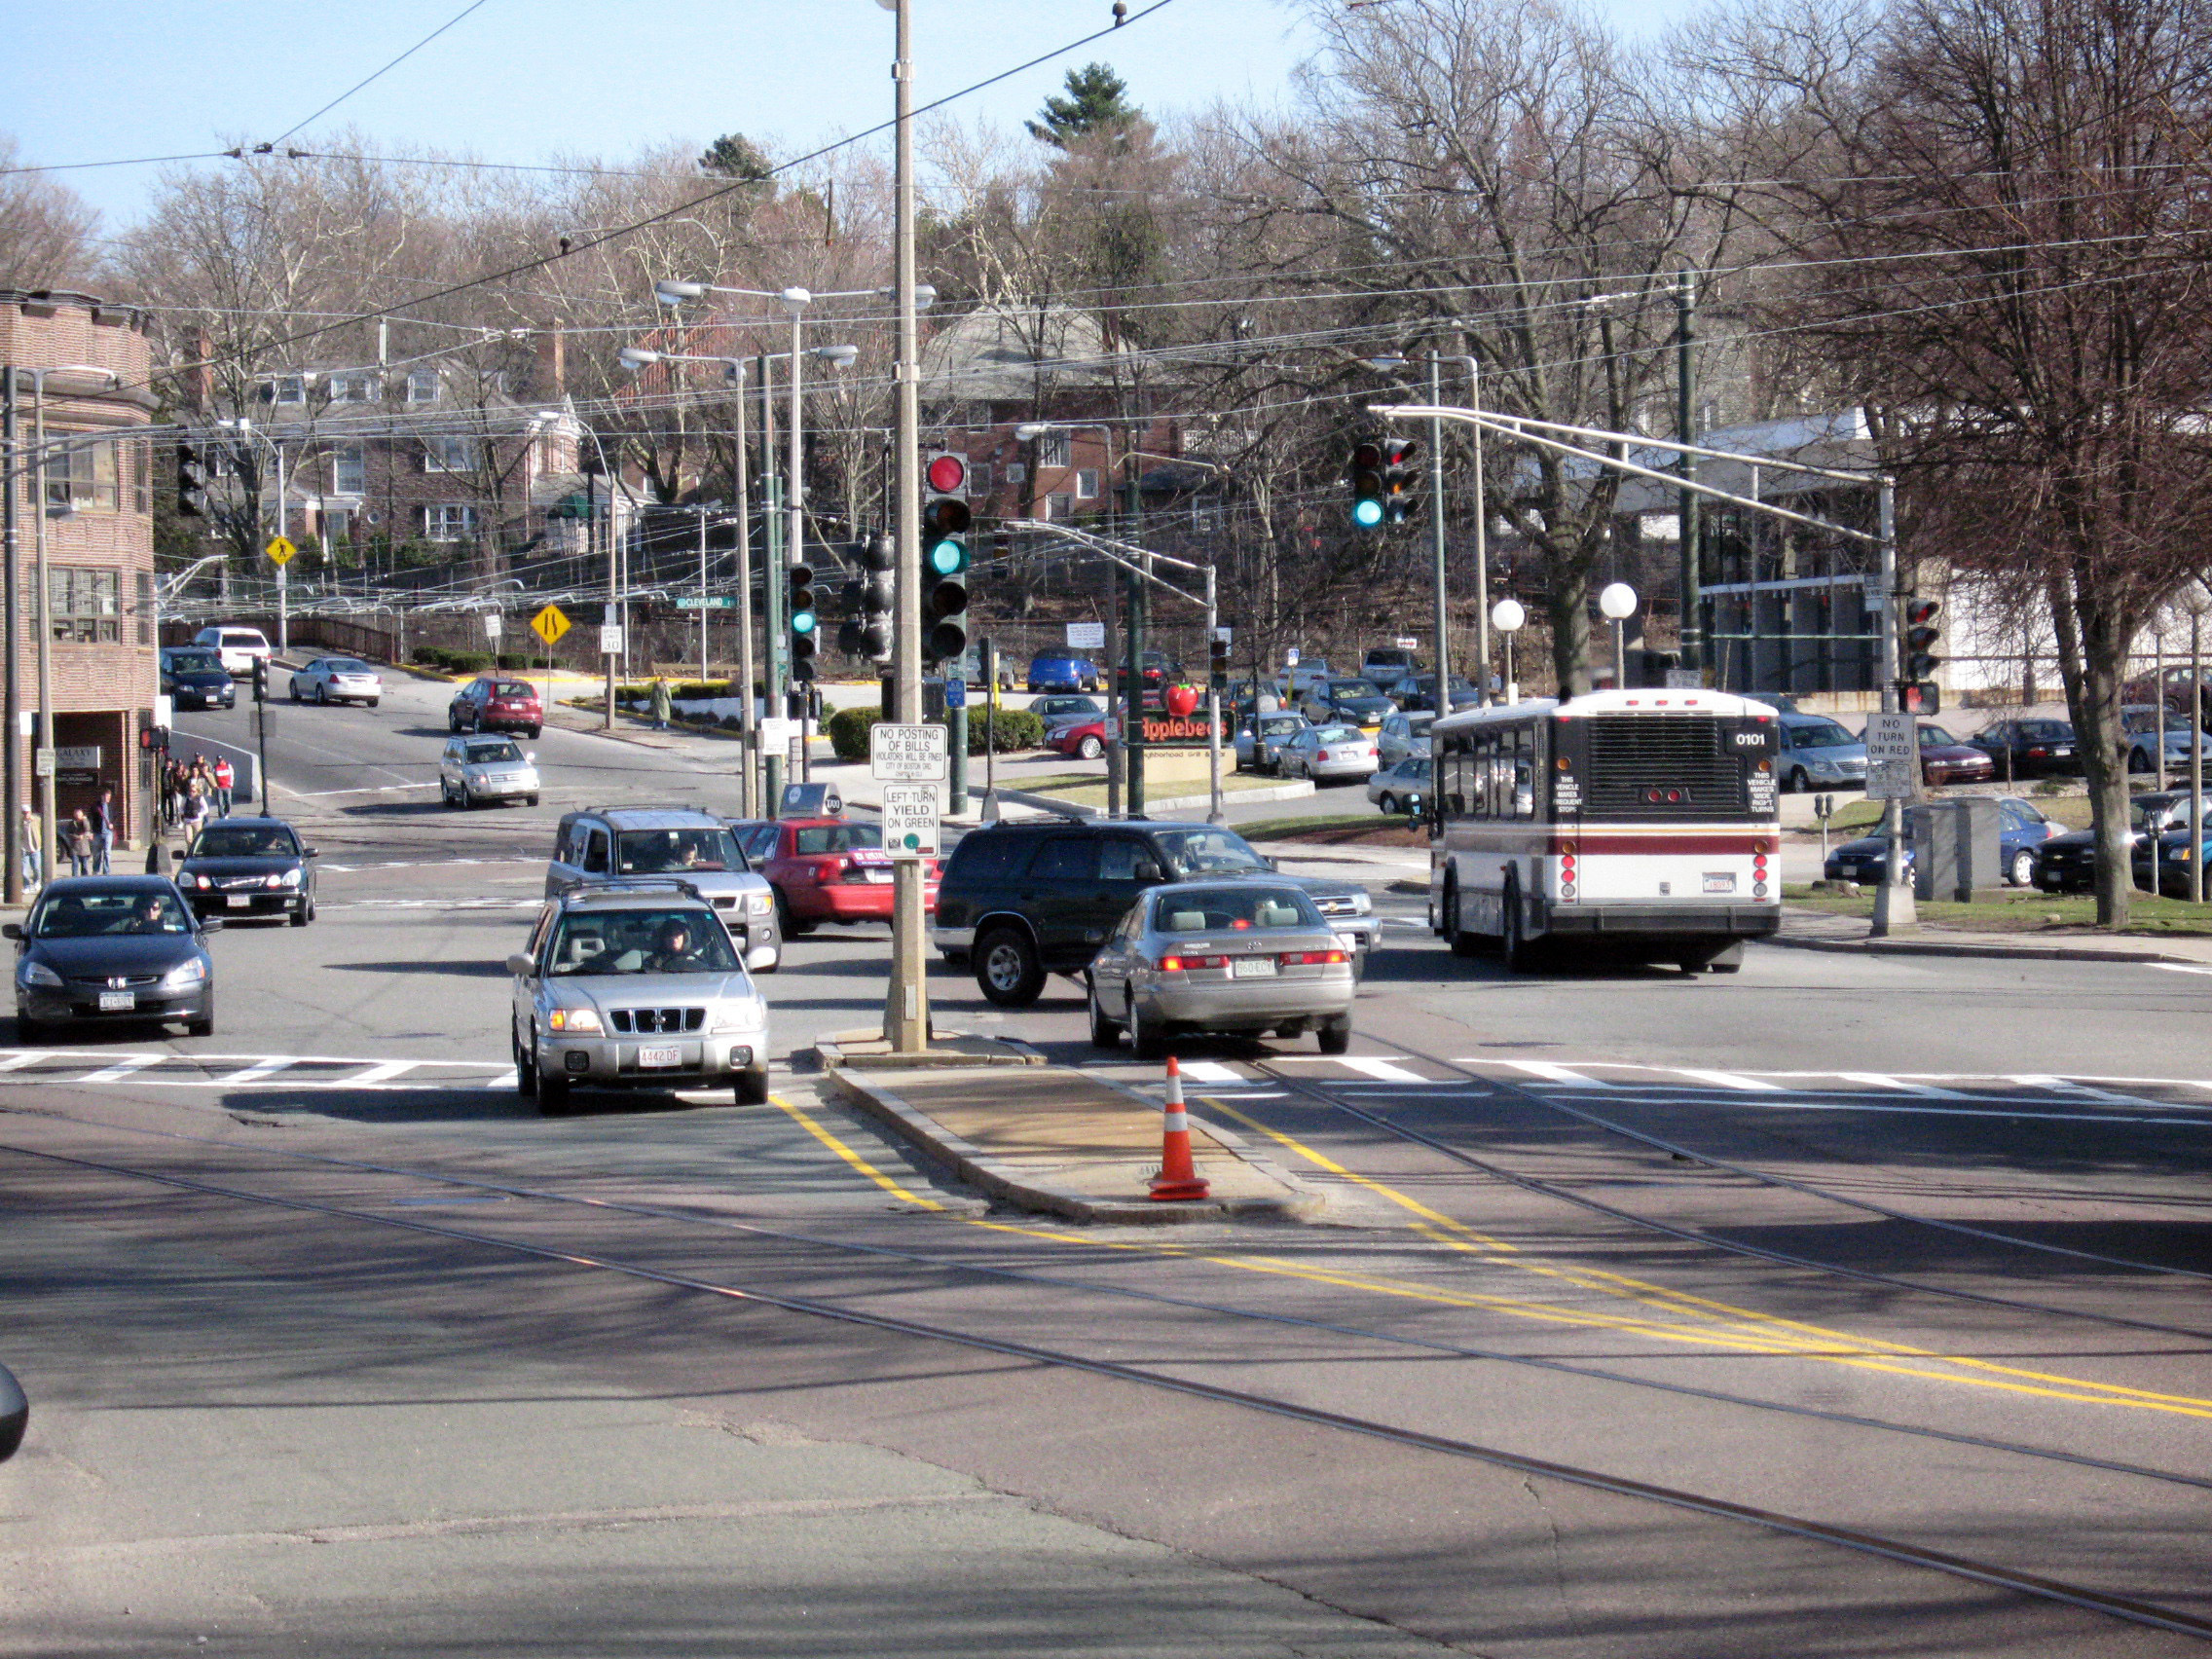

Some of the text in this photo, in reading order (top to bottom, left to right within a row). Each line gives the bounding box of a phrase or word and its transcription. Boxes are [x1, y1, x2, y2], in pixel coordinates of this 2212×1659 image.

[604, 641, 619, 649] 30
[1883, 719, 1900, 728] NO
[880, 729, 939, 740] NO POSTING
[1736, 733, 1766, 746] 0101
[1877, 732, 1905, 742] TURN
[888, 741, 930, 752] OF BILLS
[1871, 745, 1910, 755] ON RED
[919, 753, 926, 761] BE
[929, 753, 943, 761] FINED
[887, 793, 935, 803] LEFT TURN
[826, 798, 840, 809] TAXI
[893, 805, 929, 815] YIELD
[888, 818, 935, 829] ON GREEN
[667, 1051, 679, 1060] DF
